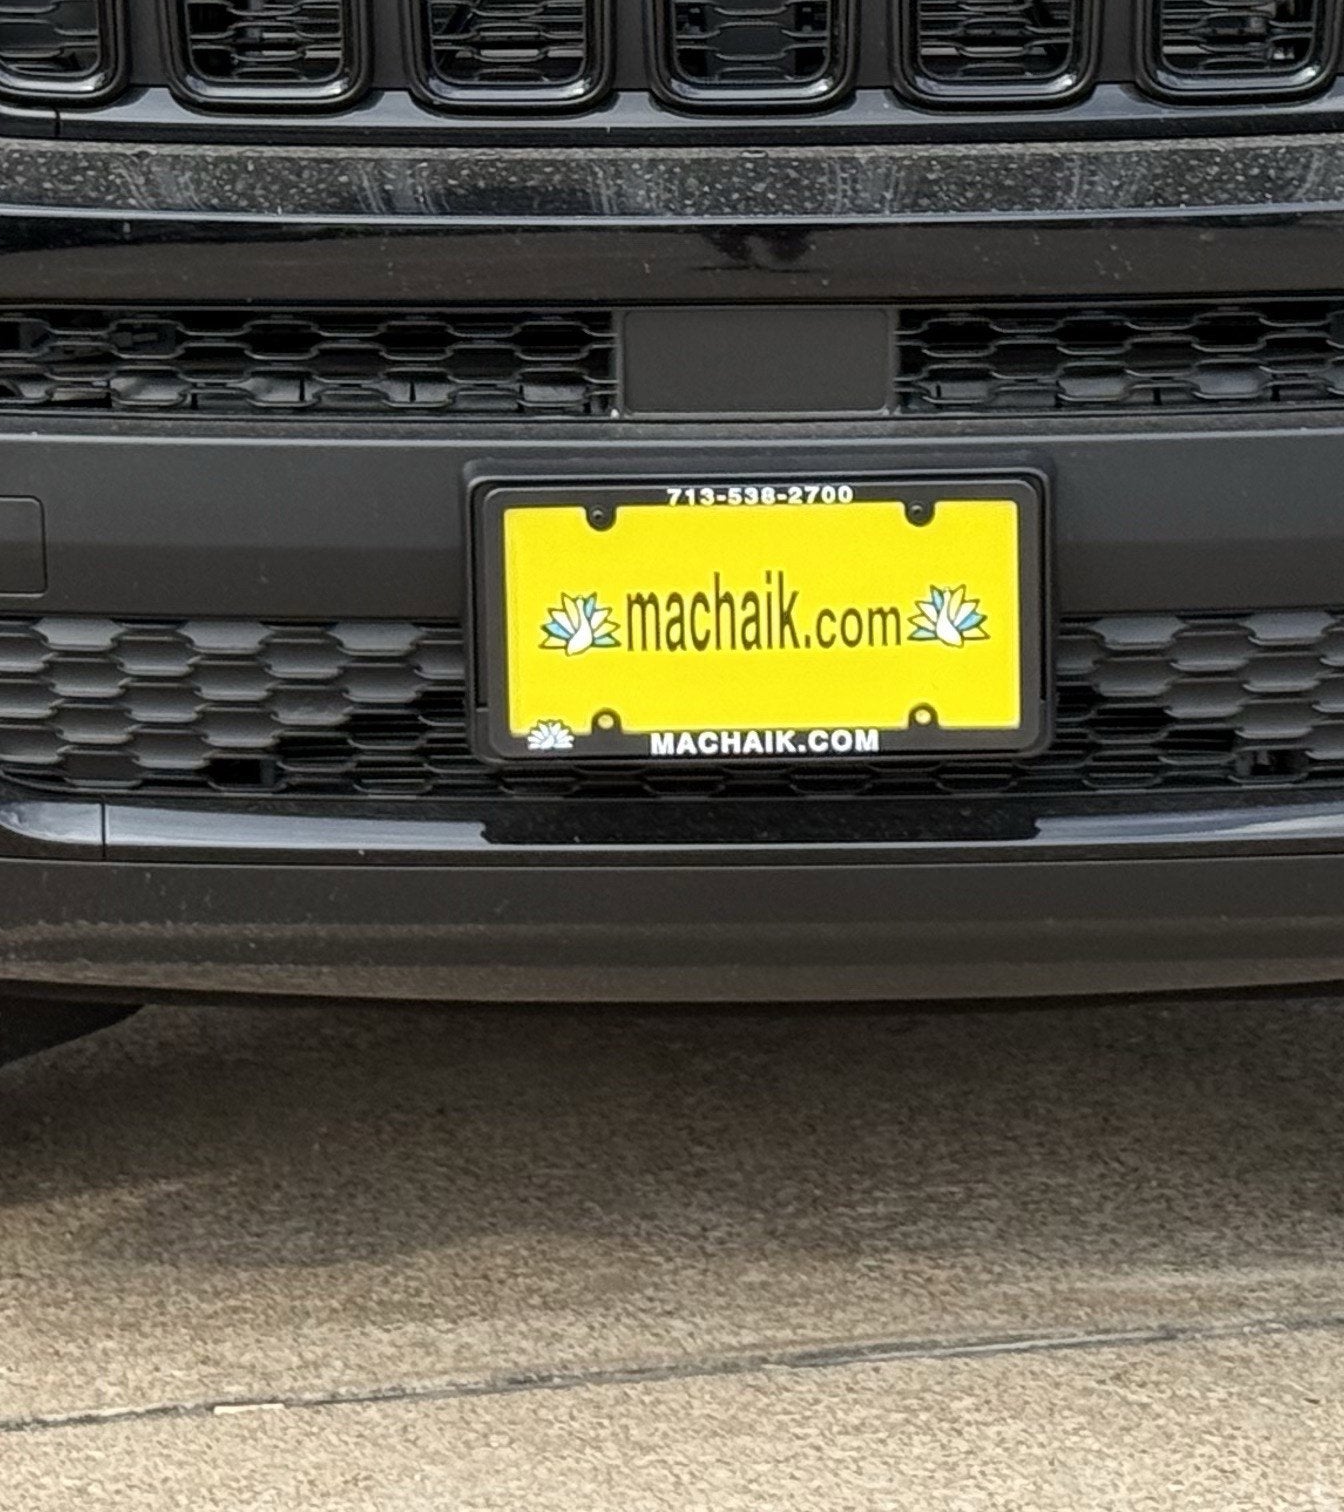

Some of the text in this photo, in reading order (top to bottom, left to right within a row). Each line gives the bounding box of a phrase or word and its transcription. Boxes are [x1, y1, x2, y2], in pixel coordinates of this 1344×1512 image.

[666, 485, 854, 506] 713-538-2700
[626, 569, 902, 652] machaik.com
[650, 729, 880, 756] MACHAIK.COM
